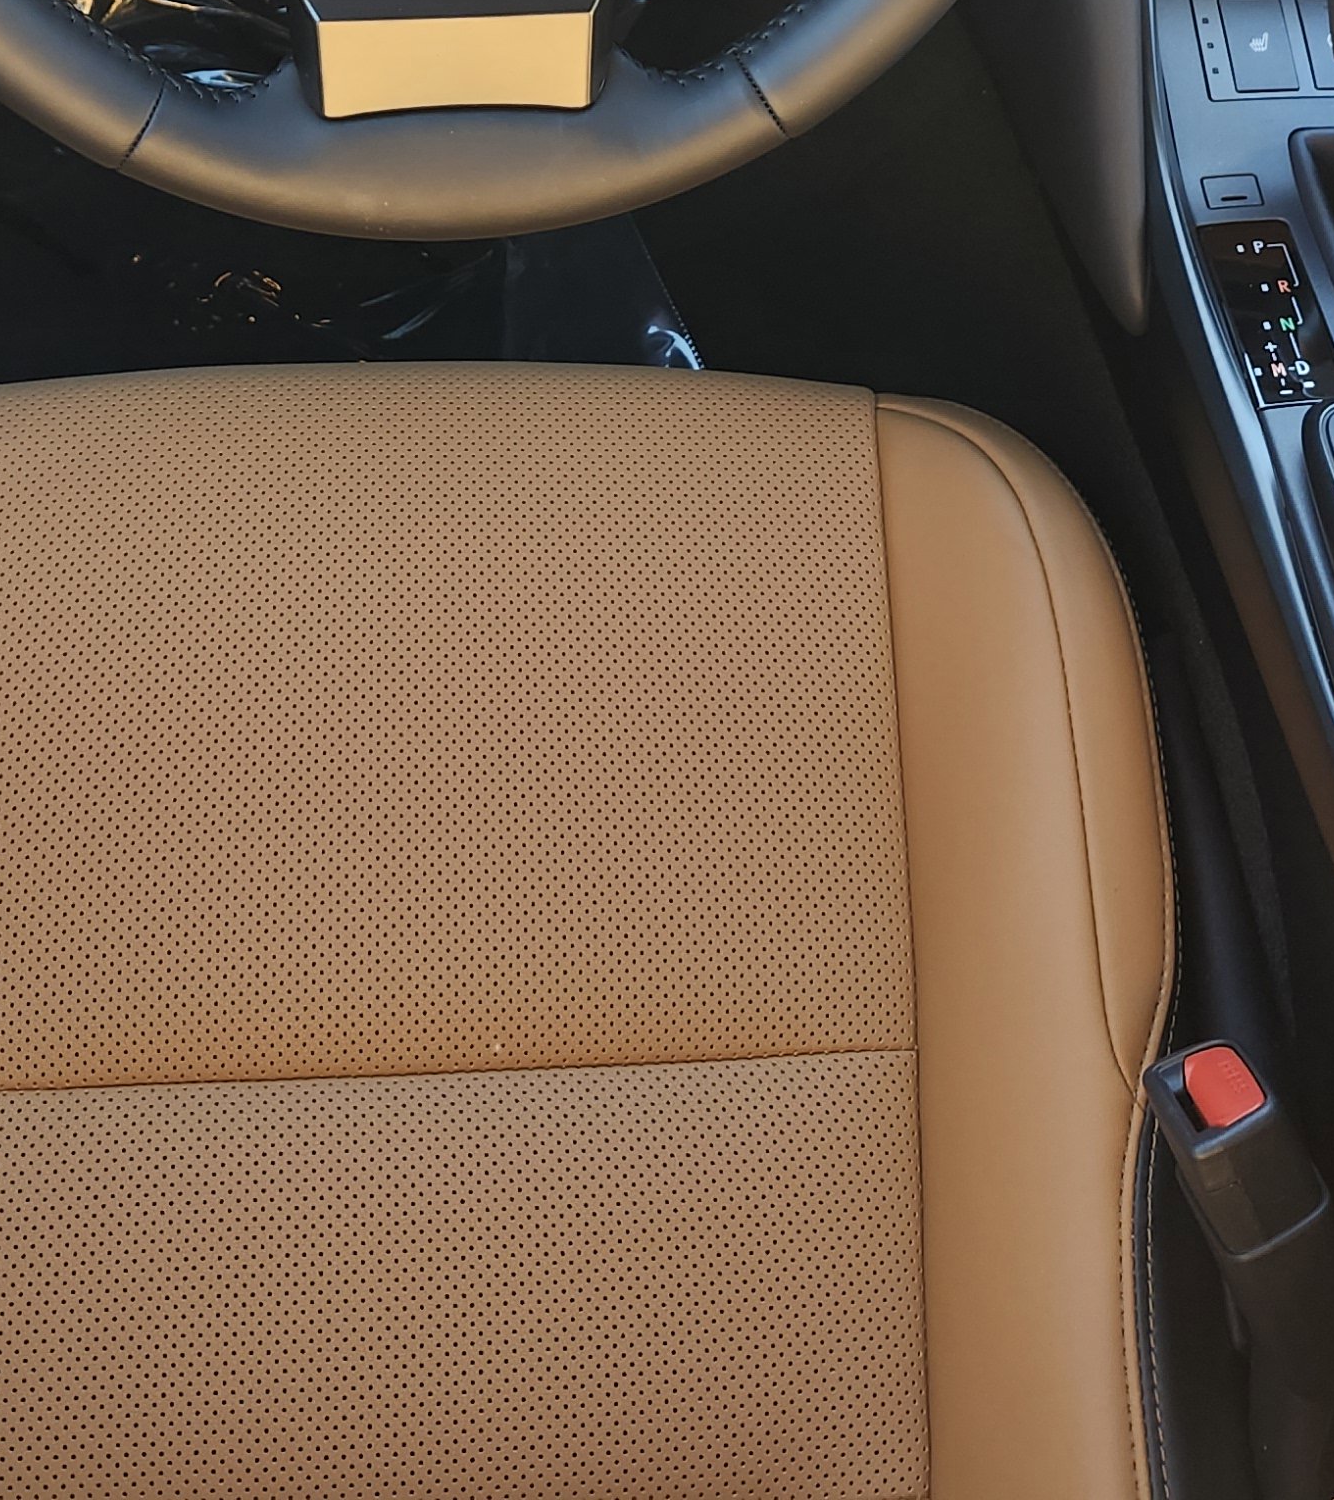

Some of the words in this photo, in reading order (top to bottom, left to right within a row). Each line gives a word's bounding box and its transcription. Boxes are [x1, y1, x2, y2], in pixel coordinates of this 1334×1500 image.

[1252, 240, 1264, 253] P
[1277, 280, 1291, 293] R
[1279, 317, 1296, 332] N
[1270, 362, 1287, 377] M
[1294, 360, 1310, 375] D
